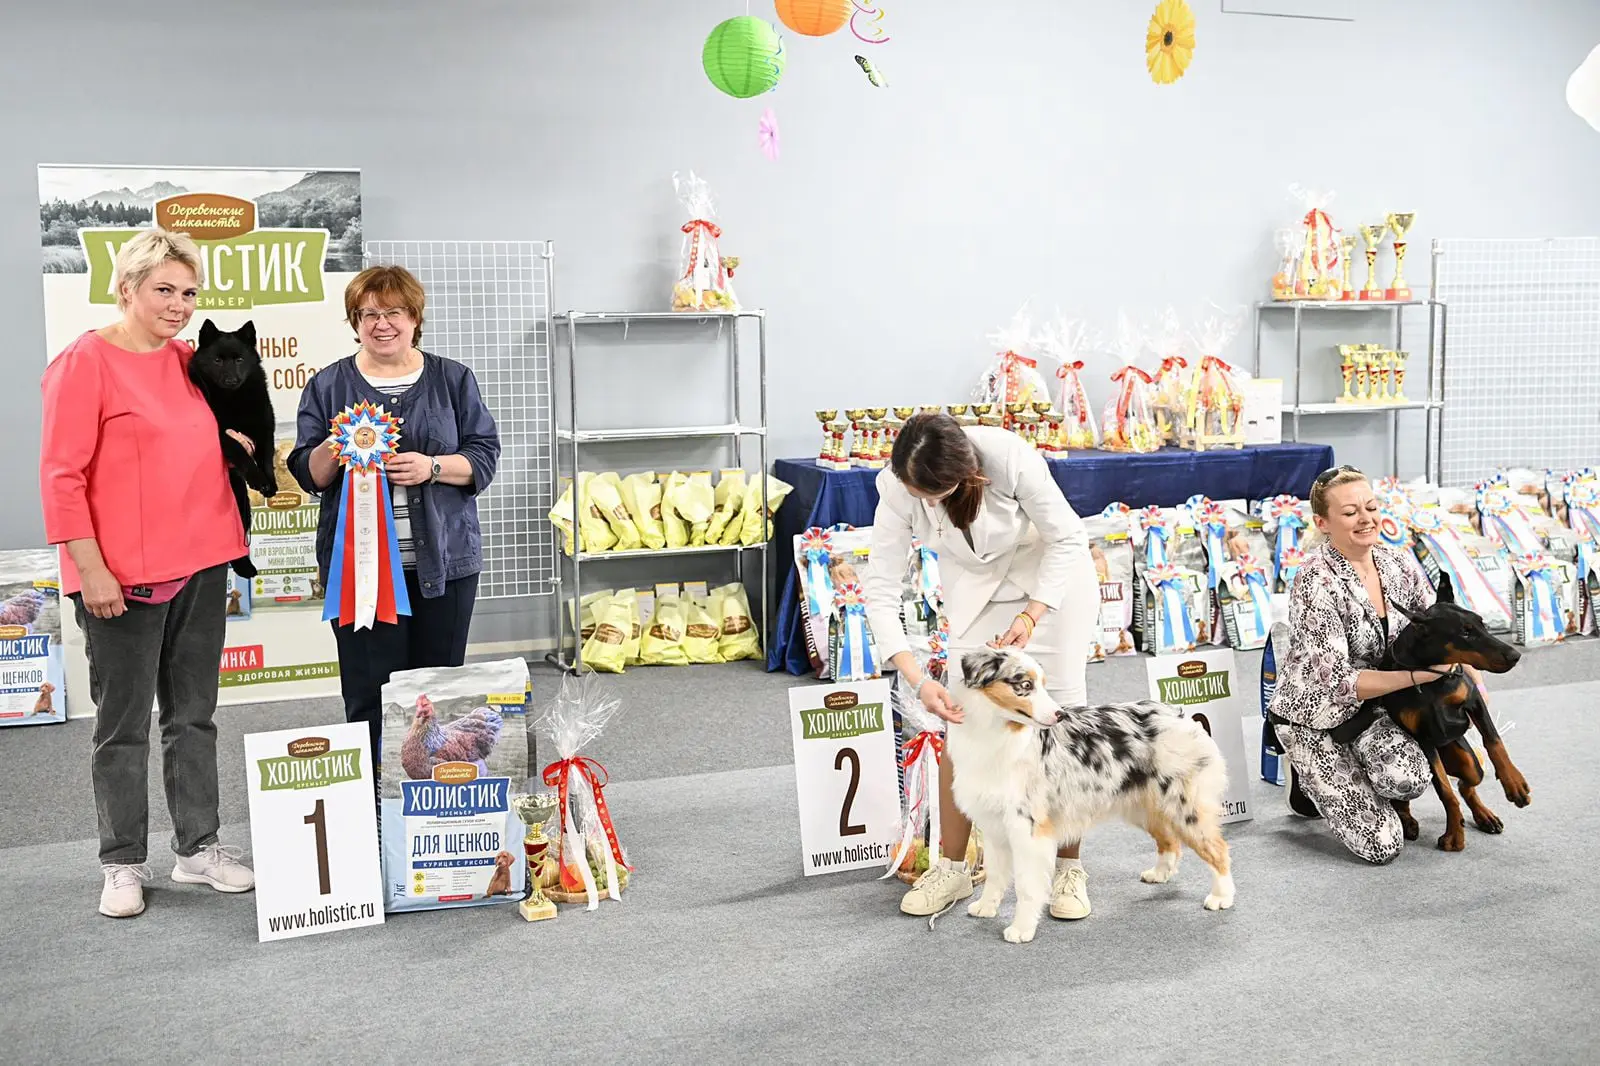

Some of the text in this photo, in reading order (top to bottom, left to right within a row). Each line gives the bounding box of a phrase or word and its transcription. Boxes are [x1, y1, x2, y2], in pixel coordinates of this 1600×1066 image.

[166, 203, 245, 219] Деревенские
[171, 216, 241, 228] лакомства
[196, 297, 245, 307] ЕМЬЕР
[274, 363, 319, 390] соб
[299, 545, 316, 555] СОБА
[0, 637, 44, 656] ИСТИК
[220, 650, 257, 669] ИНКА
[2, 670, 43, 685] ЩЕНКОВ
[237, 671, 291, 682] ЗДОРОВАЯ
[295, 666, 334, 677] ЖИЗНЬ!
[1164, 674, 1226, 702] ХОЛИСТИК
[807, 707, 879, 735] ХОЛИСТИК
[266, 752, 356, 787] ХОЛИСТИК
[410, 783, 501, 812] ХОЛИСТИК
[834, 747, 867, 837] 2
[303, 799, 332, 896] 1
[412, 831, 500, 857] ДЛЯ ЩЕНКОВ
[811, 842, 890, 868] www.holistic.r
[423, 861, 453, 869] КУРИЦА
[268, 902, 375, 933] www.holistic.ru
